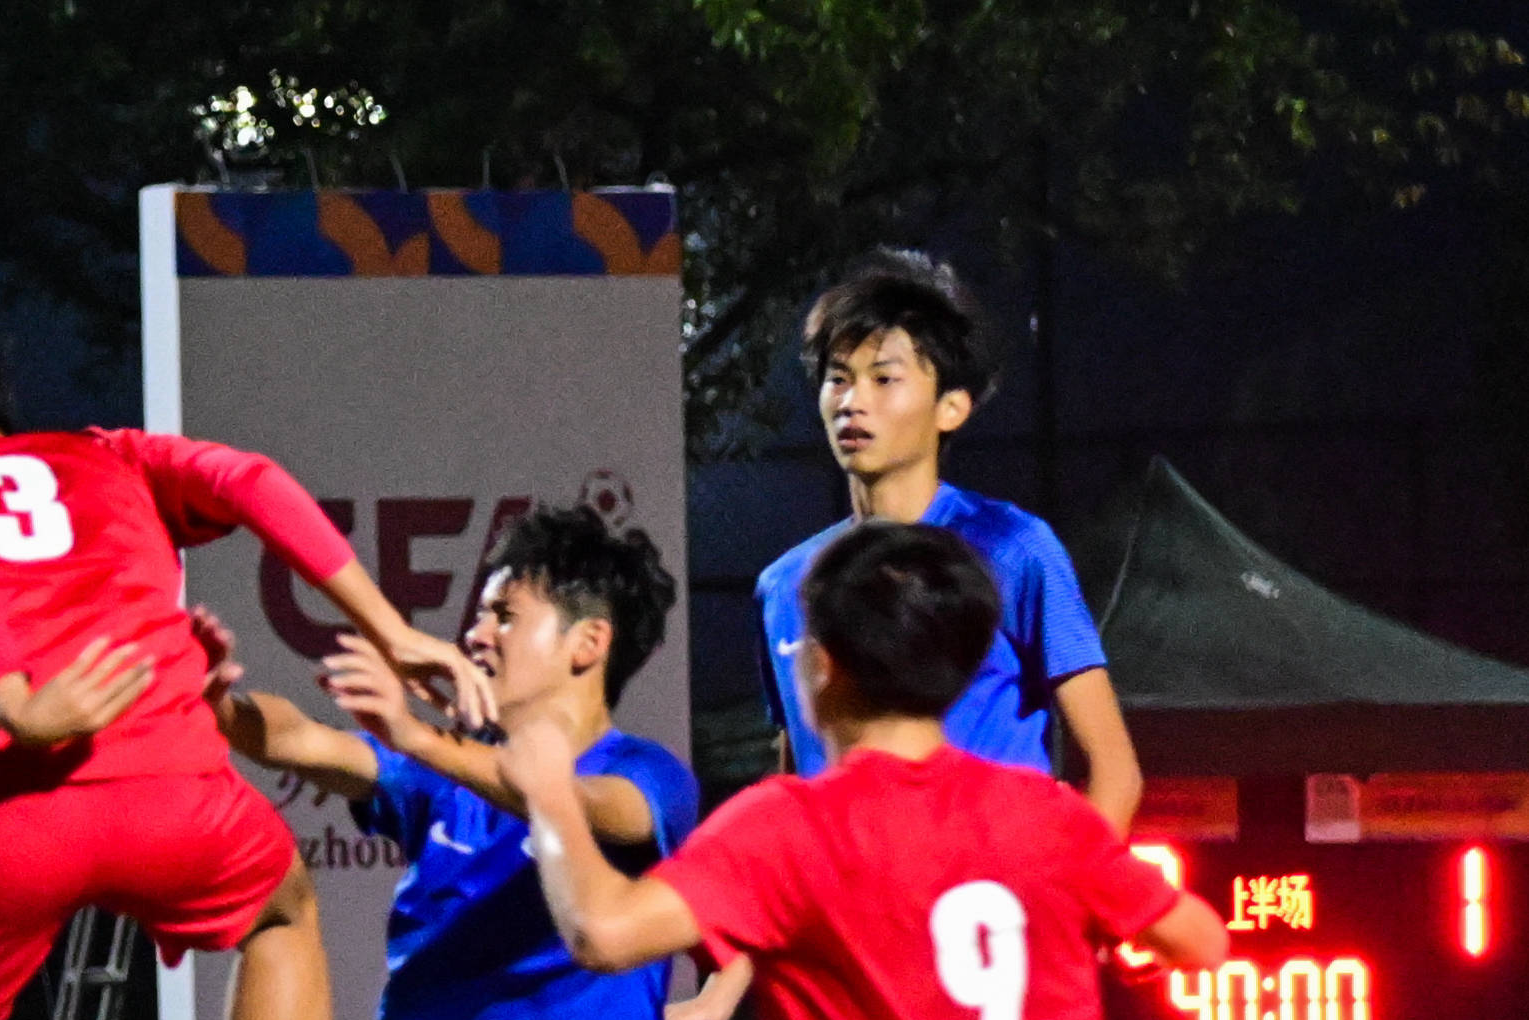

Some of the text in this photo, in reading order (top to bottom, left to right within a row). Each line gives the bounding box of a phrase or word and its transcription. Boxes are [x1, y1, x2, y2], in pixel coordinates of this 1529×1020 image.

[259, 496, 535, 662] CF
[1227, 874, 1313, 931] 上半场
[1461, 845, 1487, 957] 1
